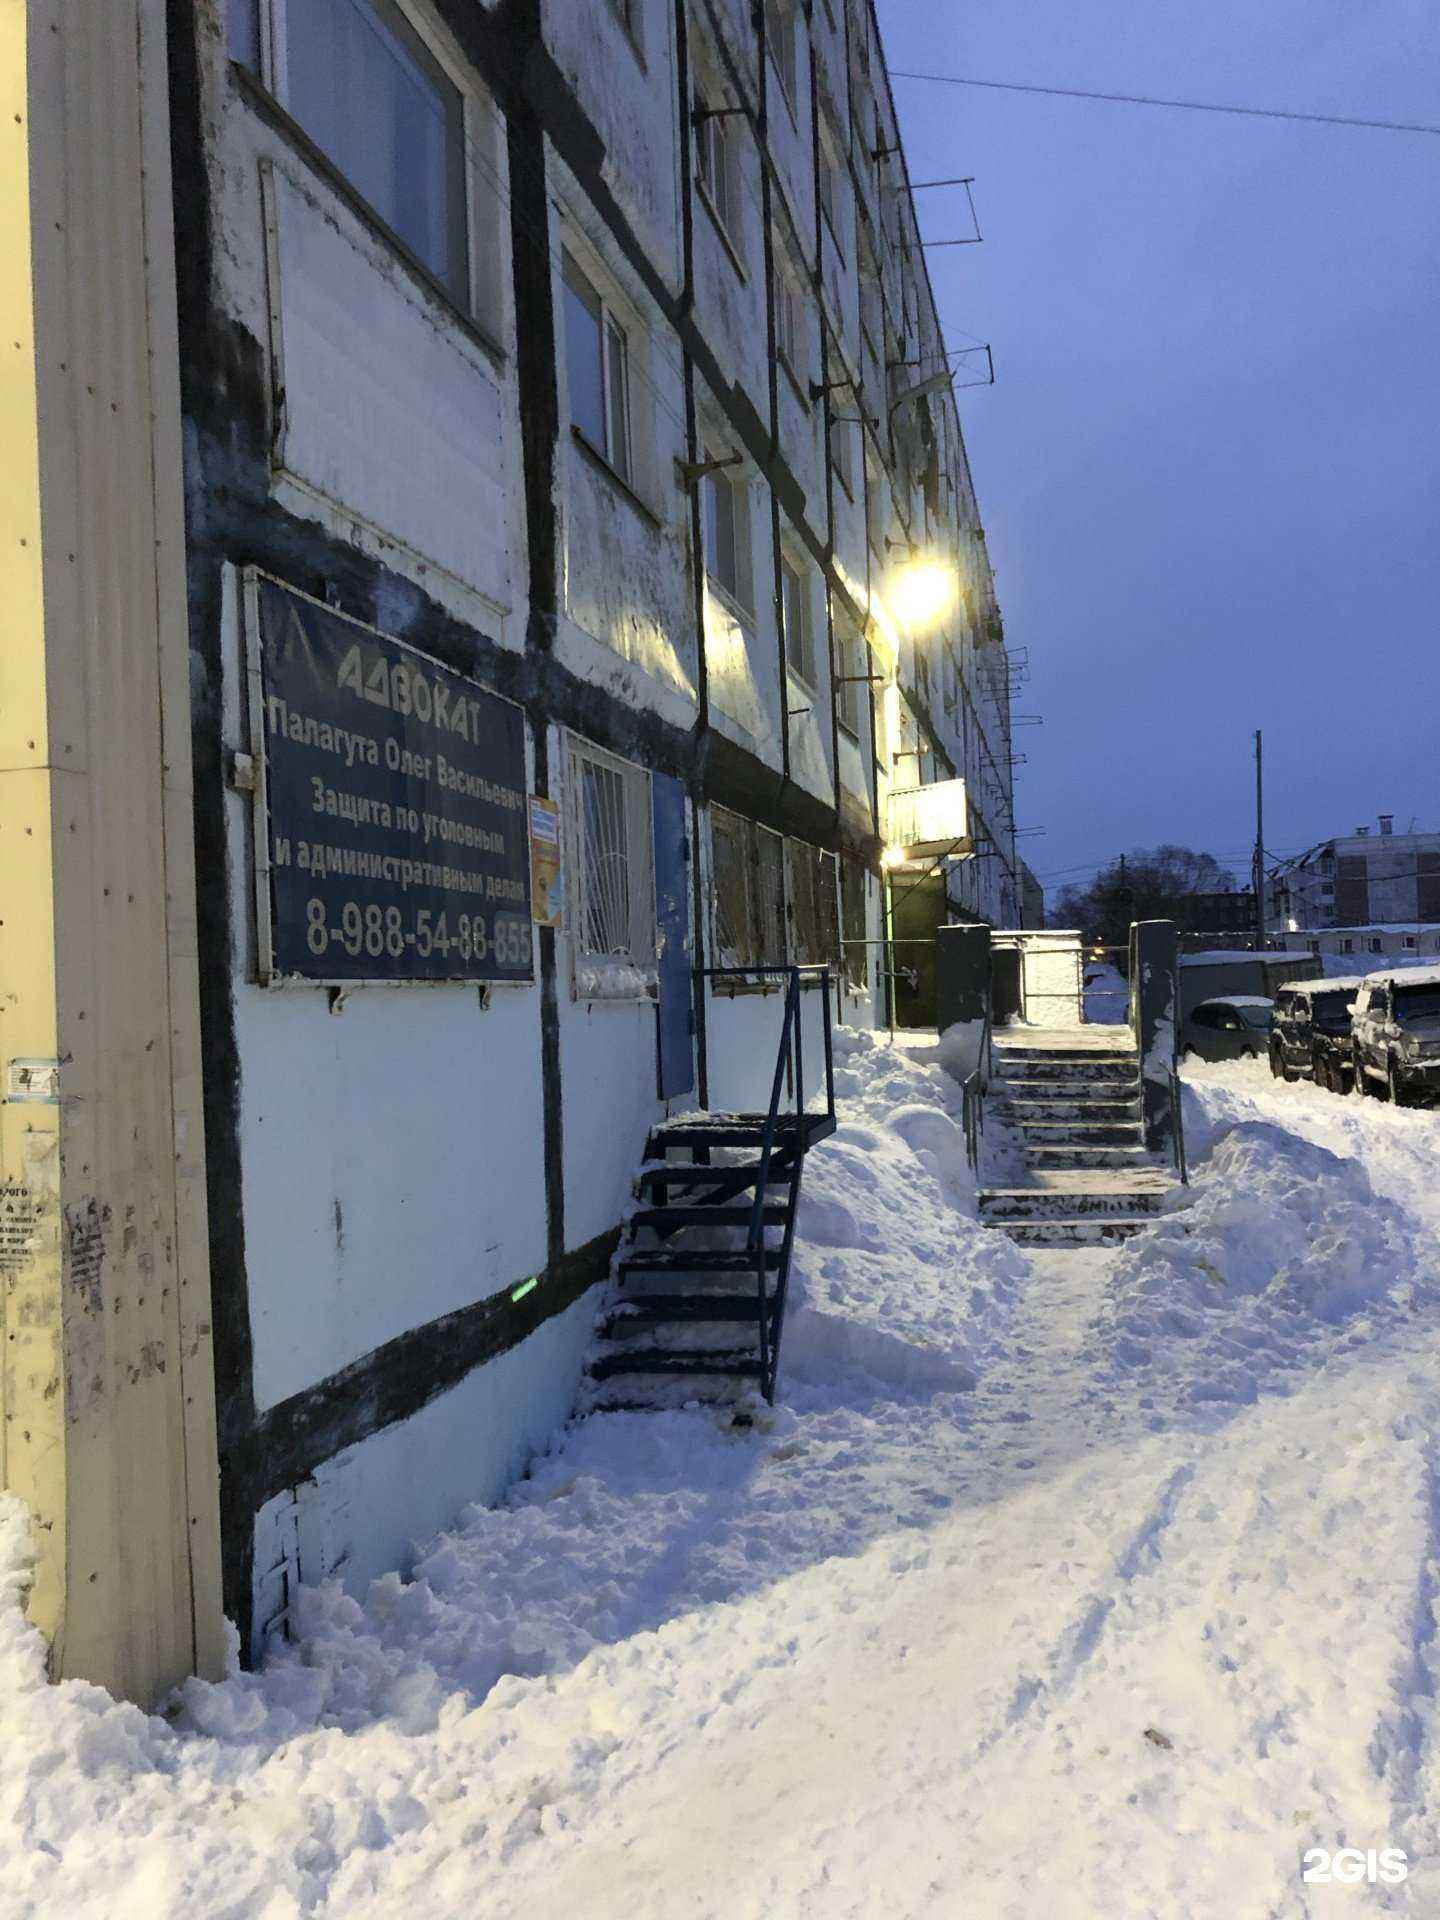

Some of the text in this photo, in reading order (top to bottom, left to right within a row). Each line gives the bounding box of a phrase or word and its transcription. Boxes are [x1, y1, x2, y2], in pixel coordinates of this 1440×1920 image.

[337, 644, 480, 745] АДВОКАТ
[269, 695, 524, 813] Палагута Олег Васильевич
[311, 776, 391, 828] Защита
[395, 806, 419, 834] по
[422, 812, 505, 855] уголовным
[297, 841, 484, 895] административным
